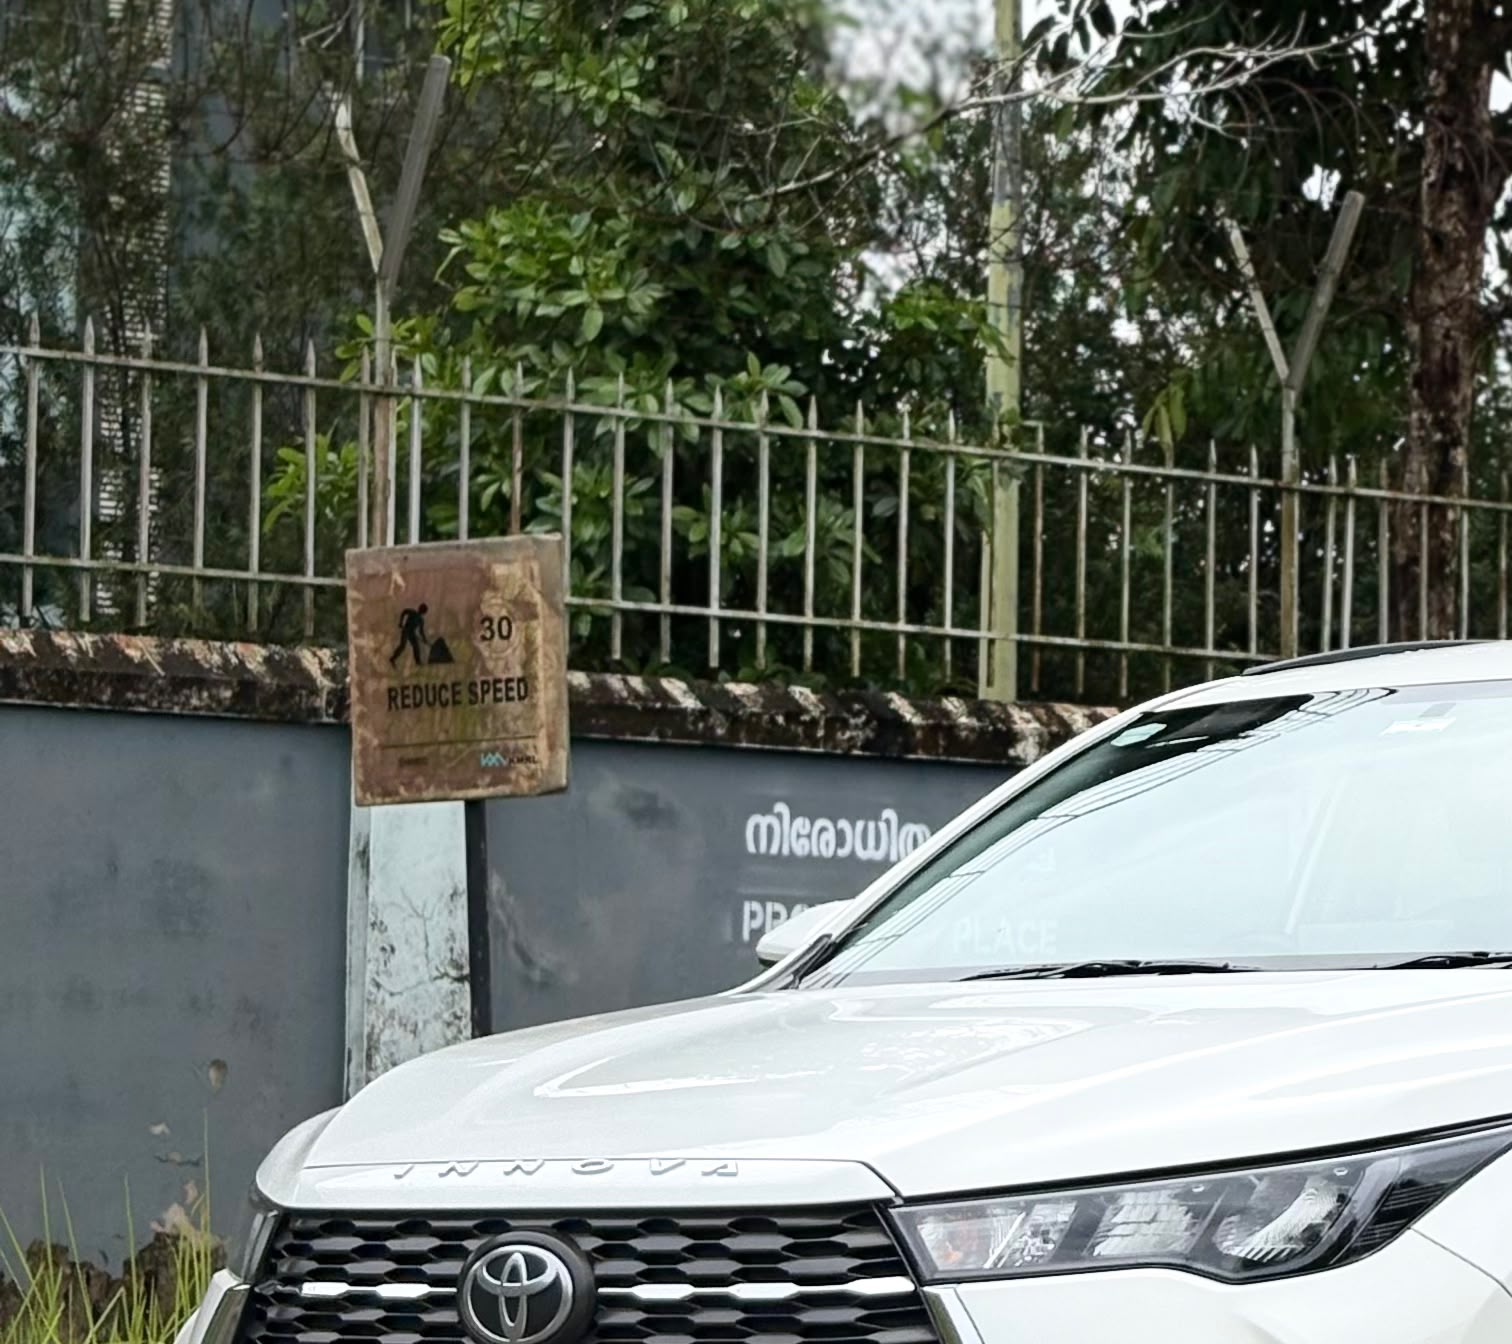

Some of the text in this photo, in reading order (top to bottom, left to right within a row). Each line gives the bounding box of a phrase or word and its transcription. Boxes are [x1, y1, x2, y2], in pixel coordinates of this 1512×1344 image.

[480, 615, 513, 641] 30
[387, 676, 529, 710] REDUCE SPEED
[393, 1157, 740, 1180] INNOVA
